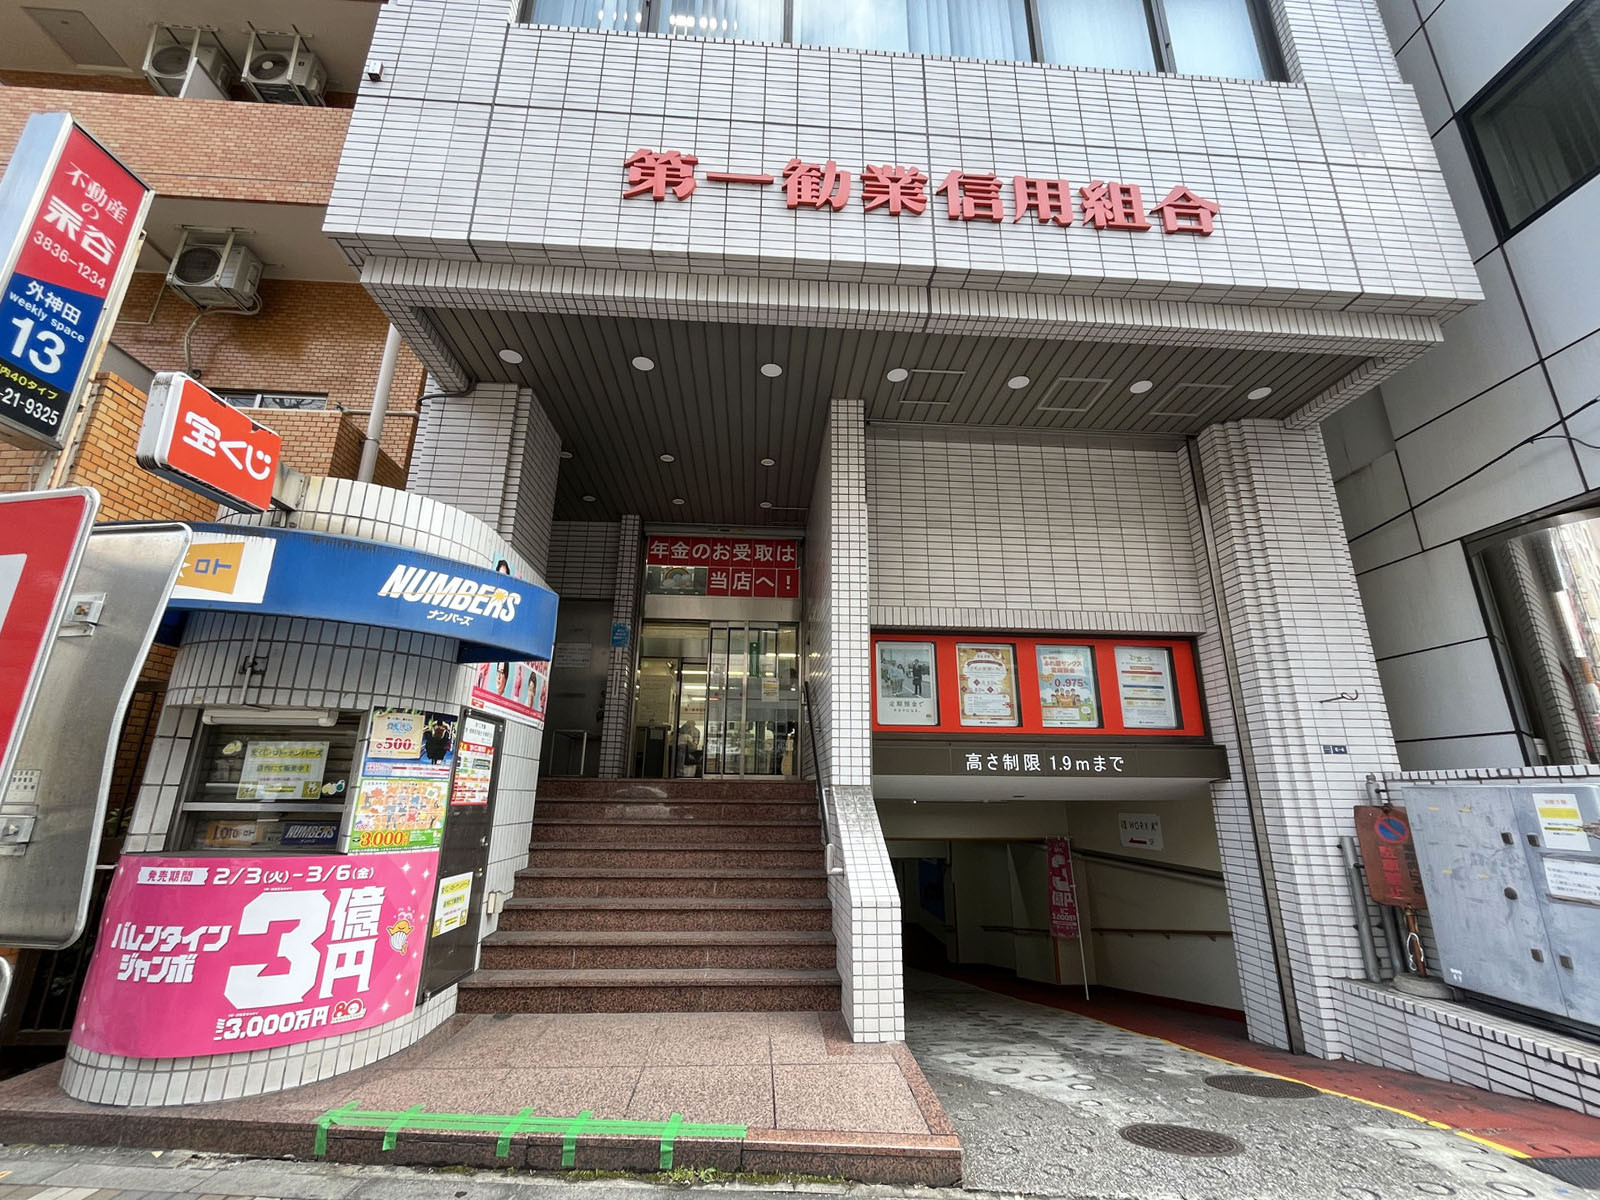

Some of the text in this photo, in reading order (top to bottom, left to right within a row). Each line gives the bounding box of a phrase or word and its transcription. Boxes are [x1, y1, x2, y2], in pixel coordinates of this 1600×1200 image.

[65, 161, 128, 225] 不動産
[622, 147, 1221, 237] 第一勧業信用組合
[81, 202, 100, 220] の
[9, 291, 48, 322] weekly
[25, 280, 82, 326] 外神田
[11, 316, 66, 374] 13
[181, 410, 272, 482] 宝くじ
[194, 558, 232, 576] ロト
[650, 540, 795, 563] 年金のお受取は
[376, 564, 522, 623] NUMBERS
[426, 609, 474, 627] ナンバーズ
[965, 753, 1124, 772] 高さ制限 1.9mまで
[284, 825, 337, 839] NUMBERS
[146, 869, 194, 883] 発売期間
[111, 921, 233, 953] バレンタイン
[117, 953, 198, 984] ジャンボ
